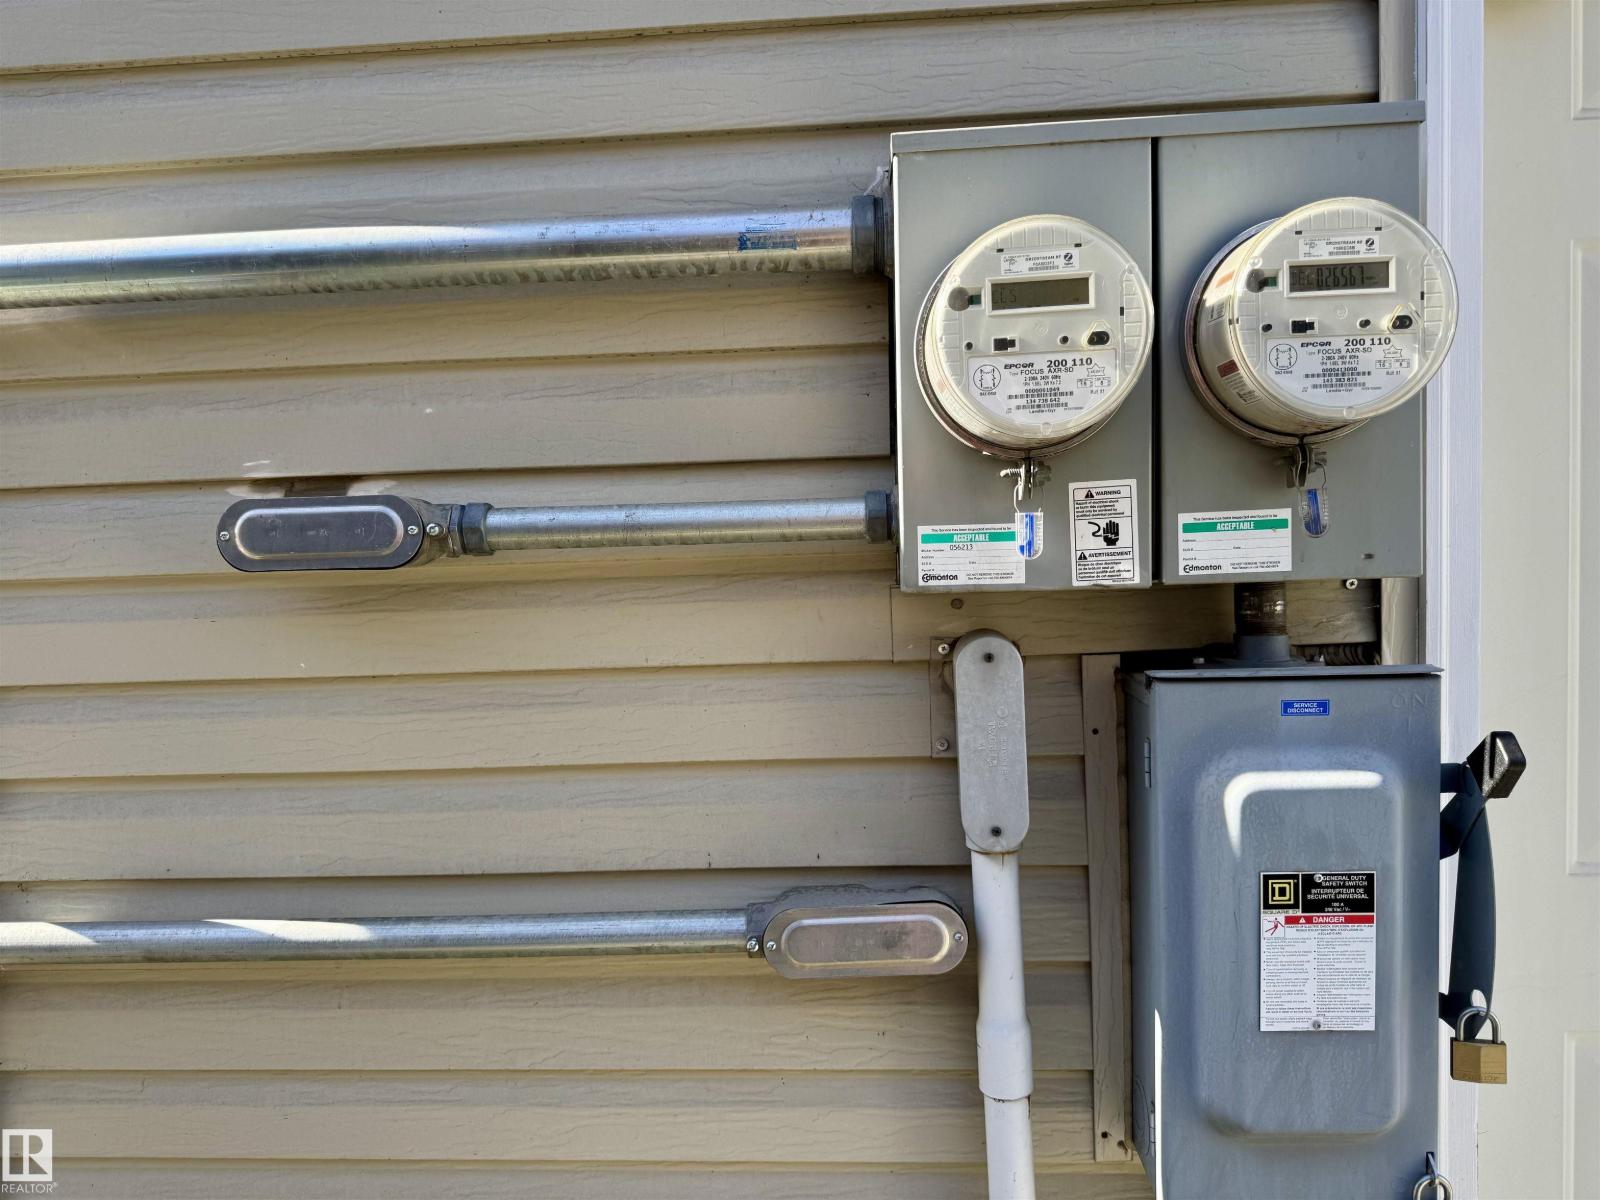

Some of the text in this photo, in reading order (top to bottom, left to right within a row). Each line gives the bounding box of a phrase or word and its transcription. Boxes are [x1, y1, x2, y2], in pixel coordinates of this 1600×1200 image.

[1344, 338, 1366, 347] 200
[1370, 337, 1391, 346] 110
[1004, 358, 1093, 370] EPCOR 200 110
[1216, 522, 1254, 531] ACCEPTABLE
[953, 534, 989, 542] ACCEPTABLE
[1183, 564, 1222, 573] Edmonton
[922, 573, 958, 582] Edmonton
